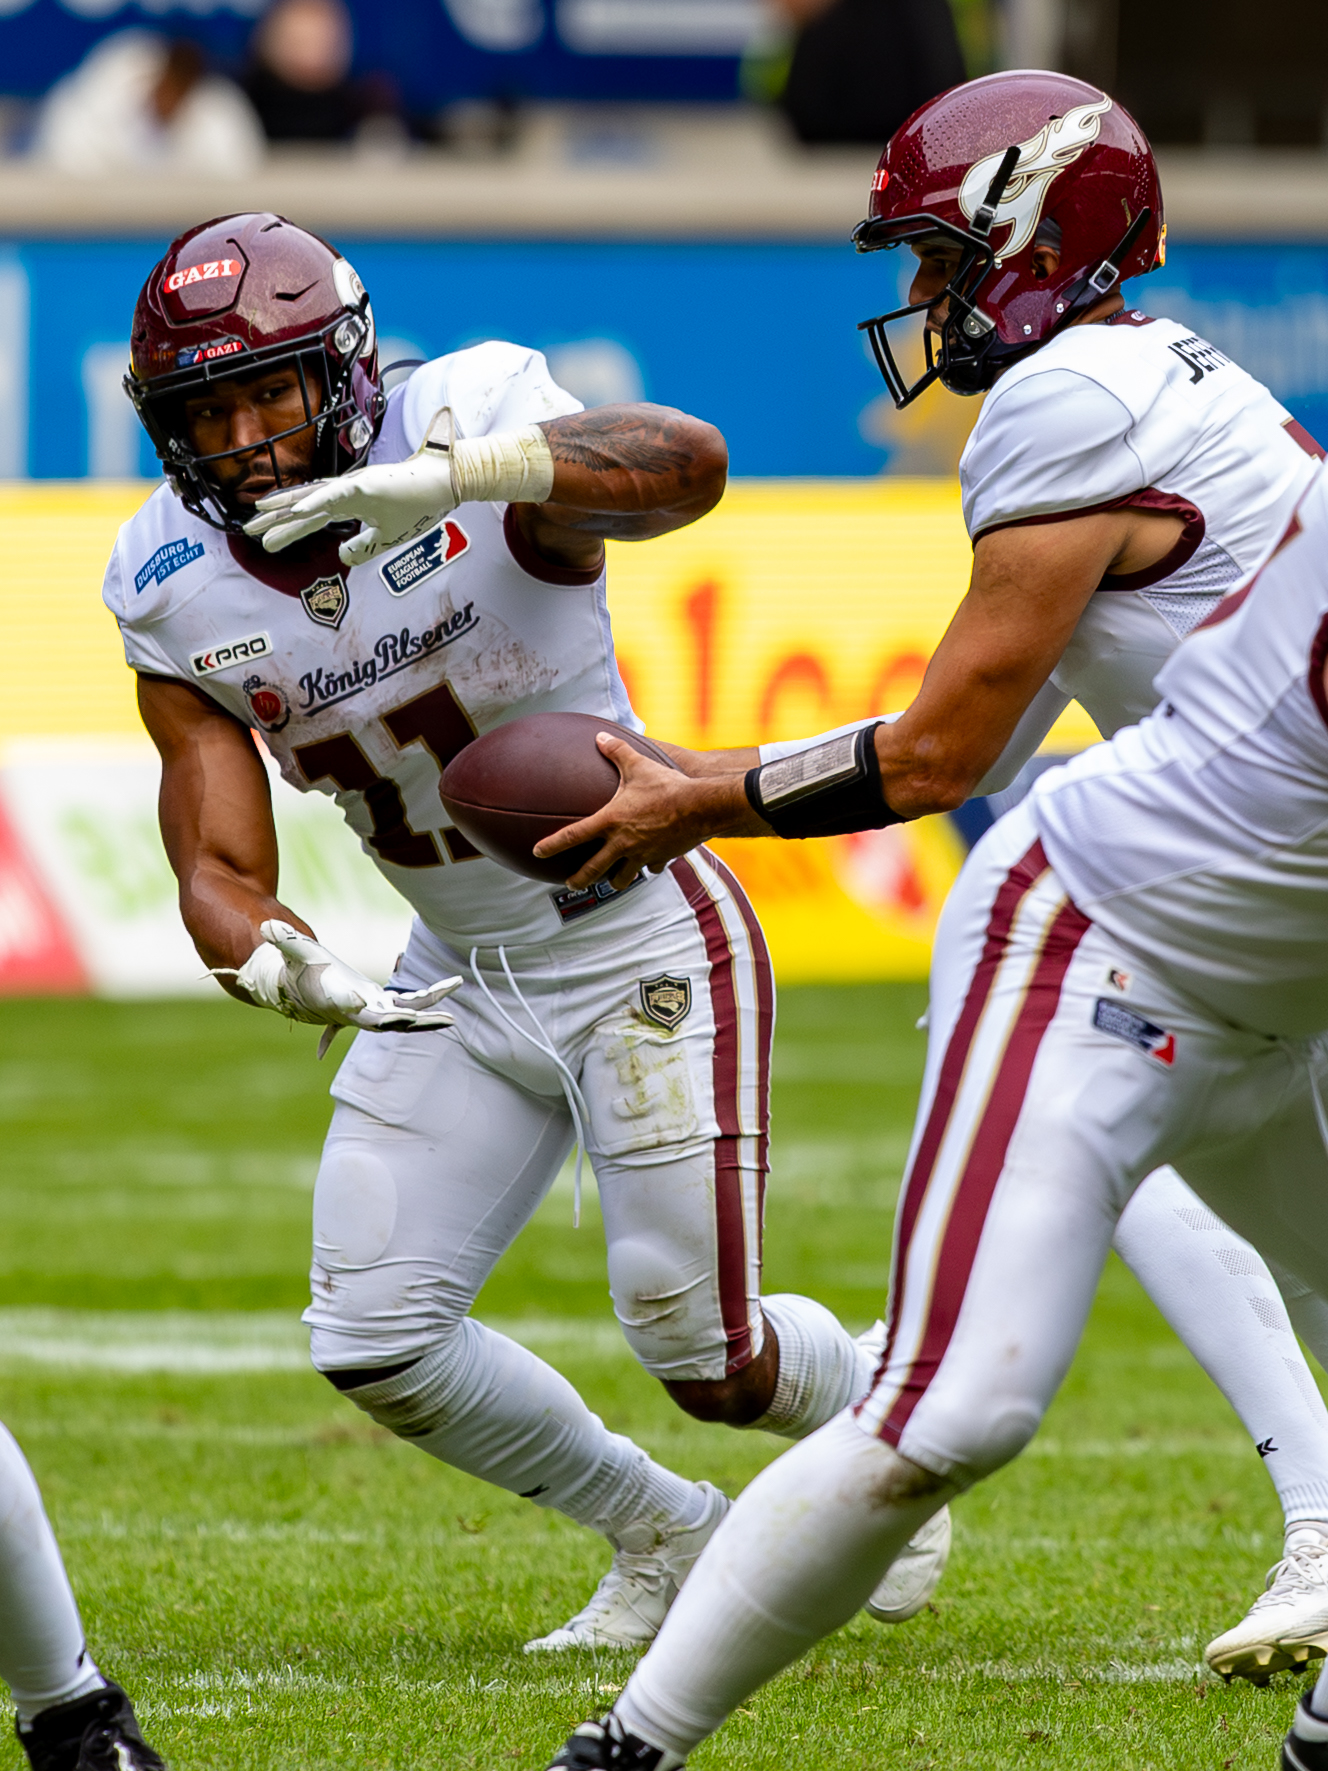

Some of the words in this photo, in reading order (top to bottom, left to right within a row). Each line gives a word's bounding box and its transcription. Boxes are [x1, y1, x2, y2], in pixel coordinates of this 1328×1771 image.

[168, 259, 233, 290] GAZI
[207, 342, 238, 358] GAZI
[137, 543, 184, 588] DUISBURG
[157, 561, 170, 579] IST
[173, 547, 199, 567] ECHT
[387, 545, 425, 574] EUROPEAN
[392, 559, 419, 581] LEAGUE
[395, 561, 433, 588] FOOTBALL
